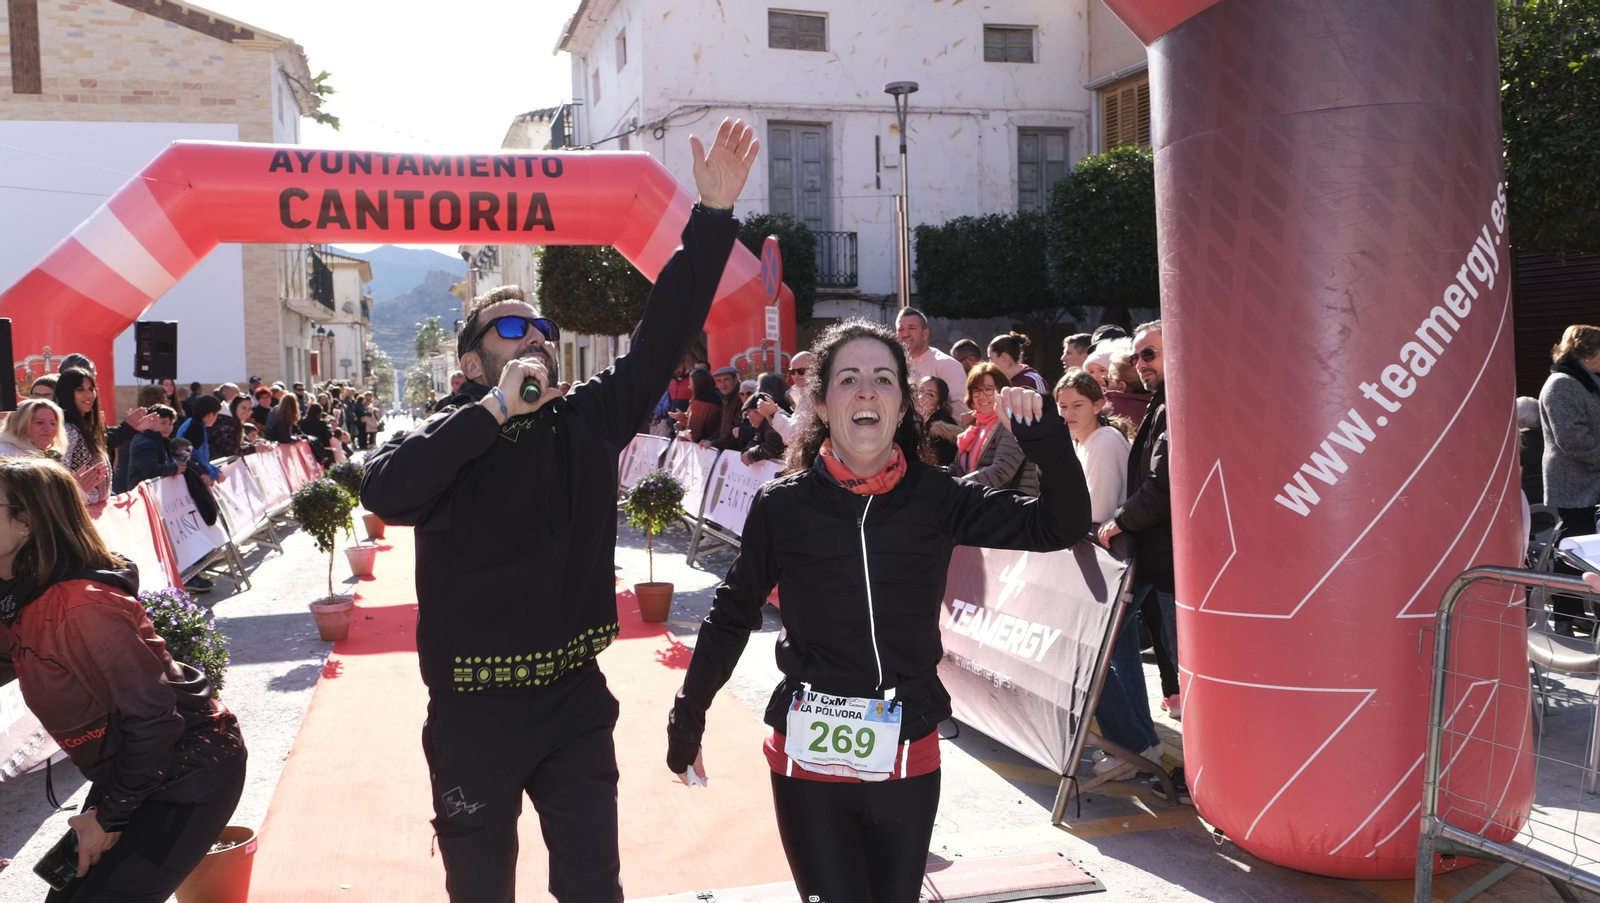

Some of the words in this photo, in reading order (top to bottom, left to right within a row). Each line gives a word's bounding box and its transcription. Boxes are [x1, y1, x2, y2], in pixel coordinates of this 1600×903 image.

[269, 151, 564, 178] AYUNTAMIENTO
[279, 187, 556, 231] CANTORIA
[1273, 181, 1507, 517] www.teamergy.es
[170, 509, 201, 544] CANT
[945, 599, 1063, 663] TEAMERGY
[800, 704, 812, 714] LA
[815, 706, 863, 720] PÓLVORA
[807, 692, 818, 702] IV
[820, 695, 847, 706] CxM
[64, 722, 108, 748] Cantor
[808, 721, 875, 758] 269
